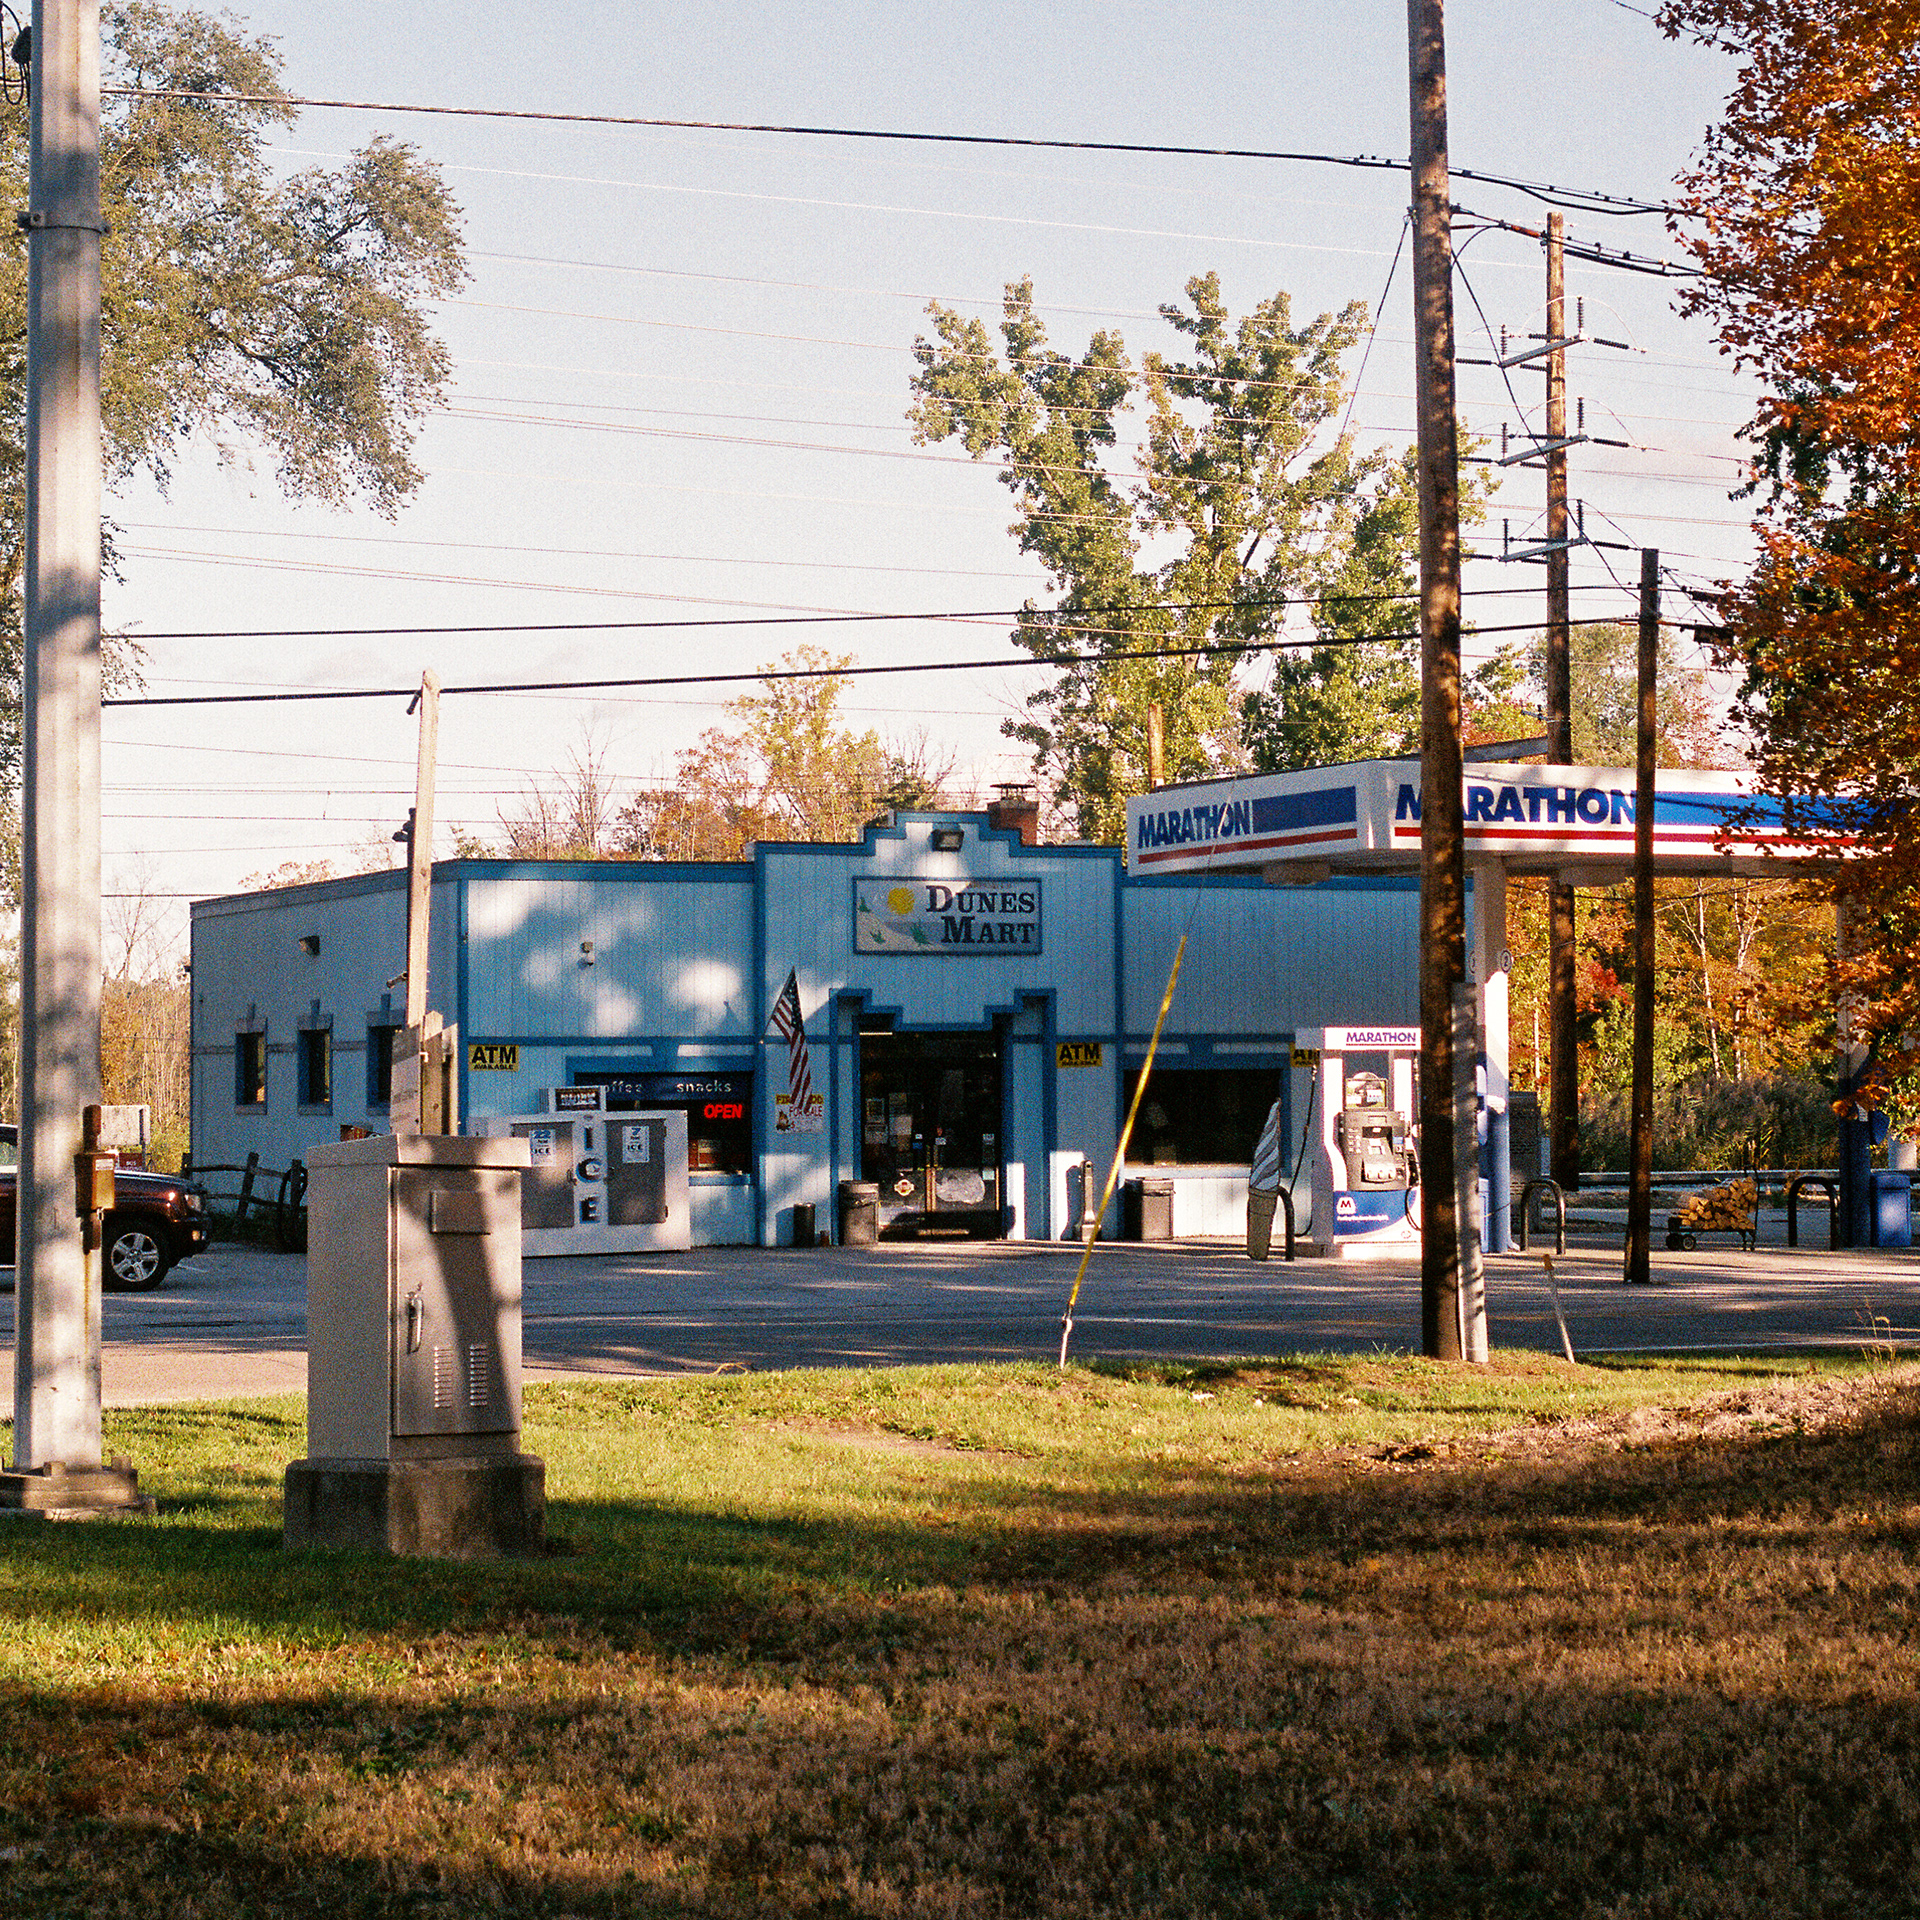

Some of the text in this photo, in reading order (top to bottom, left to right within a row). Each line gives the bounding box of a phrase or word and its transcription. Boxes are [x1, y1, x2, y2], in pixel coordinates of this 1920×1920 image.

[1395, 783, 1636, 824] MRATHON
[1138, 800, 1251, 849] MARATHON
[926, 884, 1036, 913] DUNES
[941, 915, 1035, 944] MART
[1346, 1032, 1416, 1043] MARATHON
[472, 1046, 516, 1063] ATM
[1060, 1044, 1099, 1060] ATM
[605, 1080, 733, 1093] offee snacks
[704, 1104, 743, 1119] OPEN
[533, 1130, 551, 1139] 22
[631, 1128, 641, 1136] 7
[1340, 1200, 1352, 1208] M
